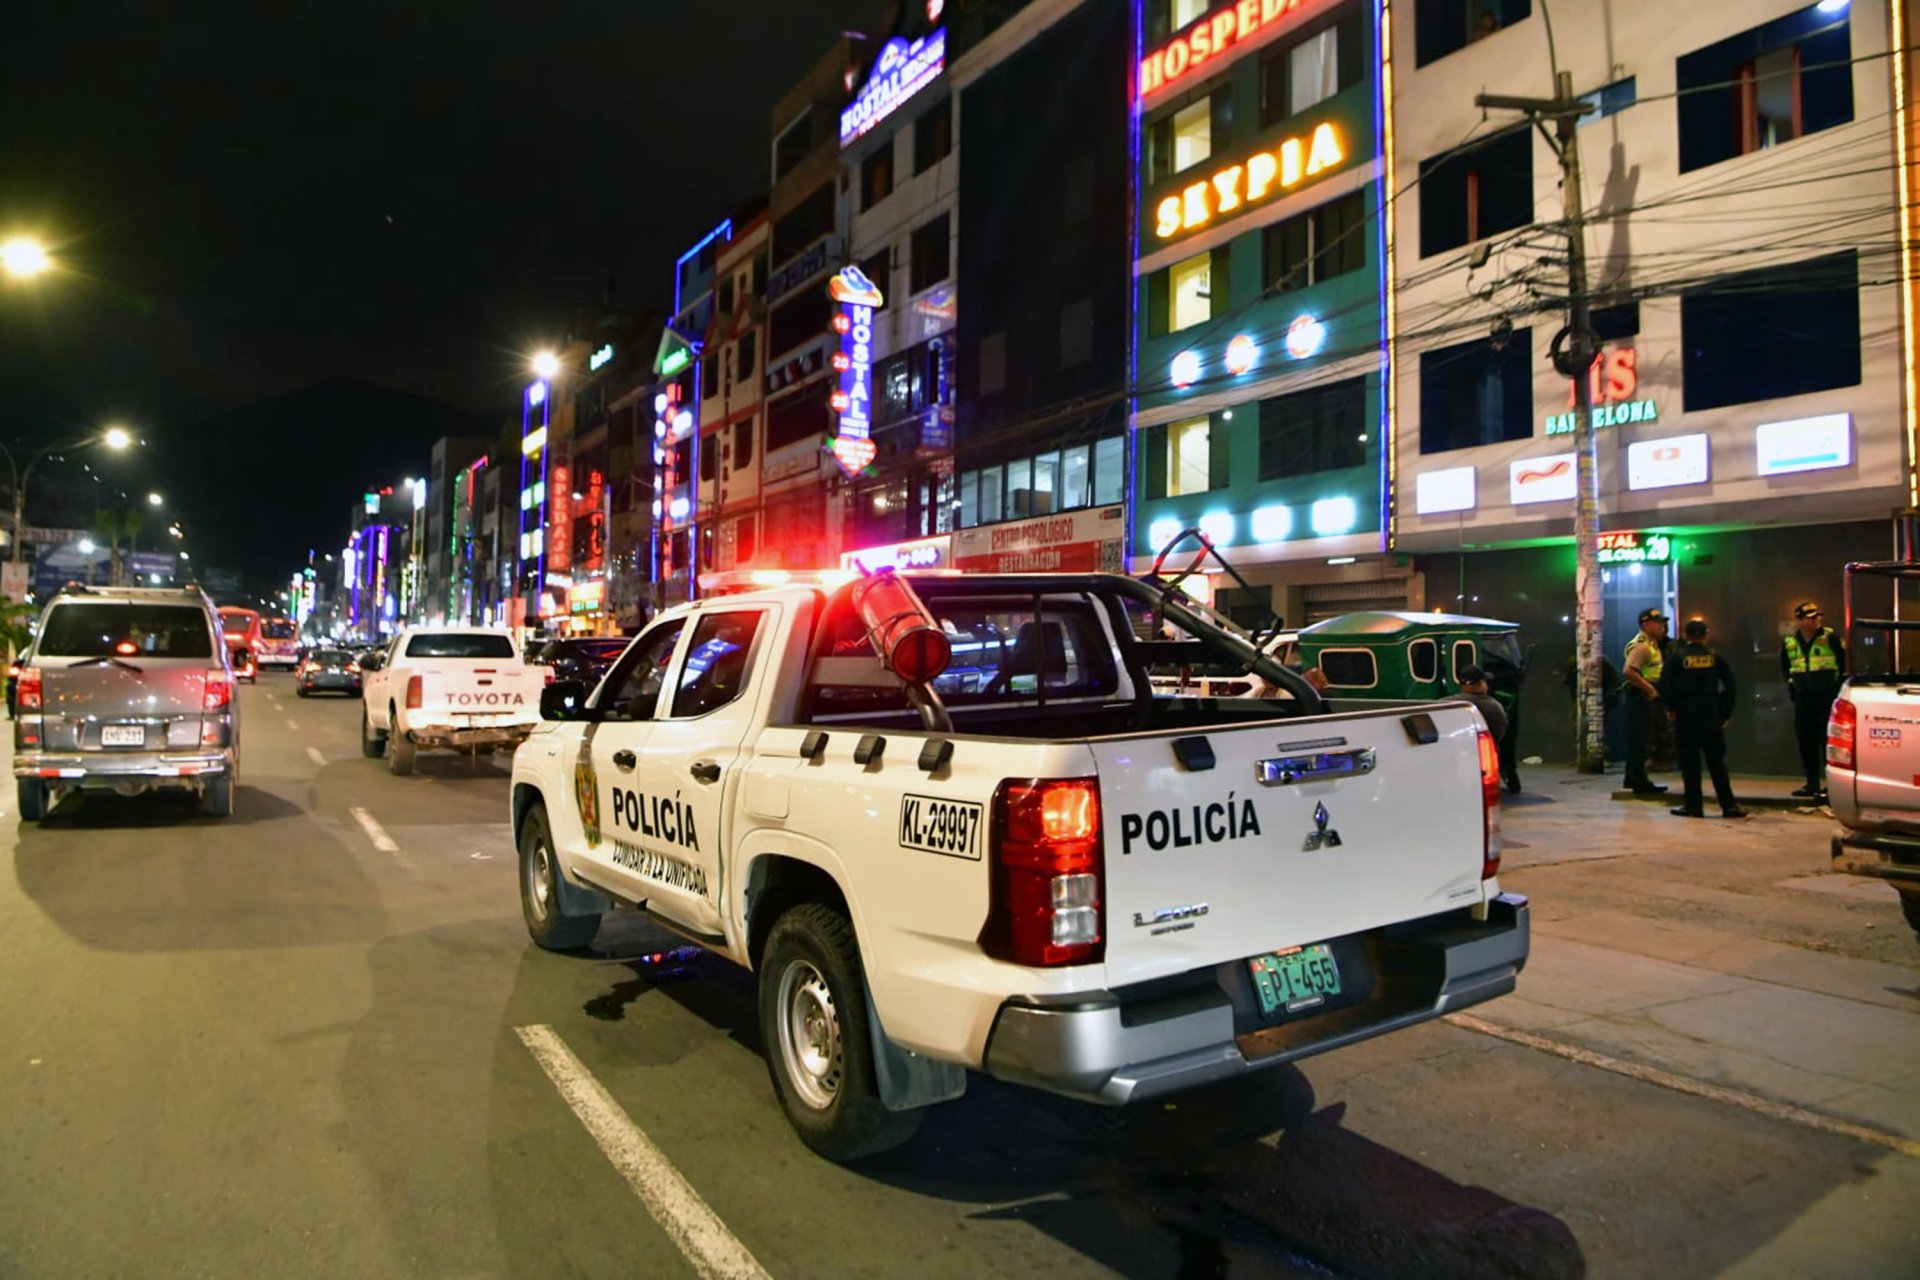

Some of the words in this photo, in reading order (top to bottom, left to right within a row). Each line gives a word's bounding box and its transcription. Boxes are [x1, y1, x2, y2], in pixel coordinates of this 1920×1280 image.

[1140, 0, 1305, 96] HOSPED
[1156, 122, 1346, 238] SKYPIA
[850, 305, 872, 419] HOSTAL
[1545, 400, 1657, 435] BAELONA
[991, 526, 1020, 551] CENTRO
[1597, 534, 1638, 549] STAL
[445, 693, 524, 705] TOYOTA
[612, 787, 700, 853] POLICÍA
[902, 799, 979, 854] KL-29997
[1121, 791, 1261, 855] POLICÍA
[664, 855, 710, 898] UNIFICADA
